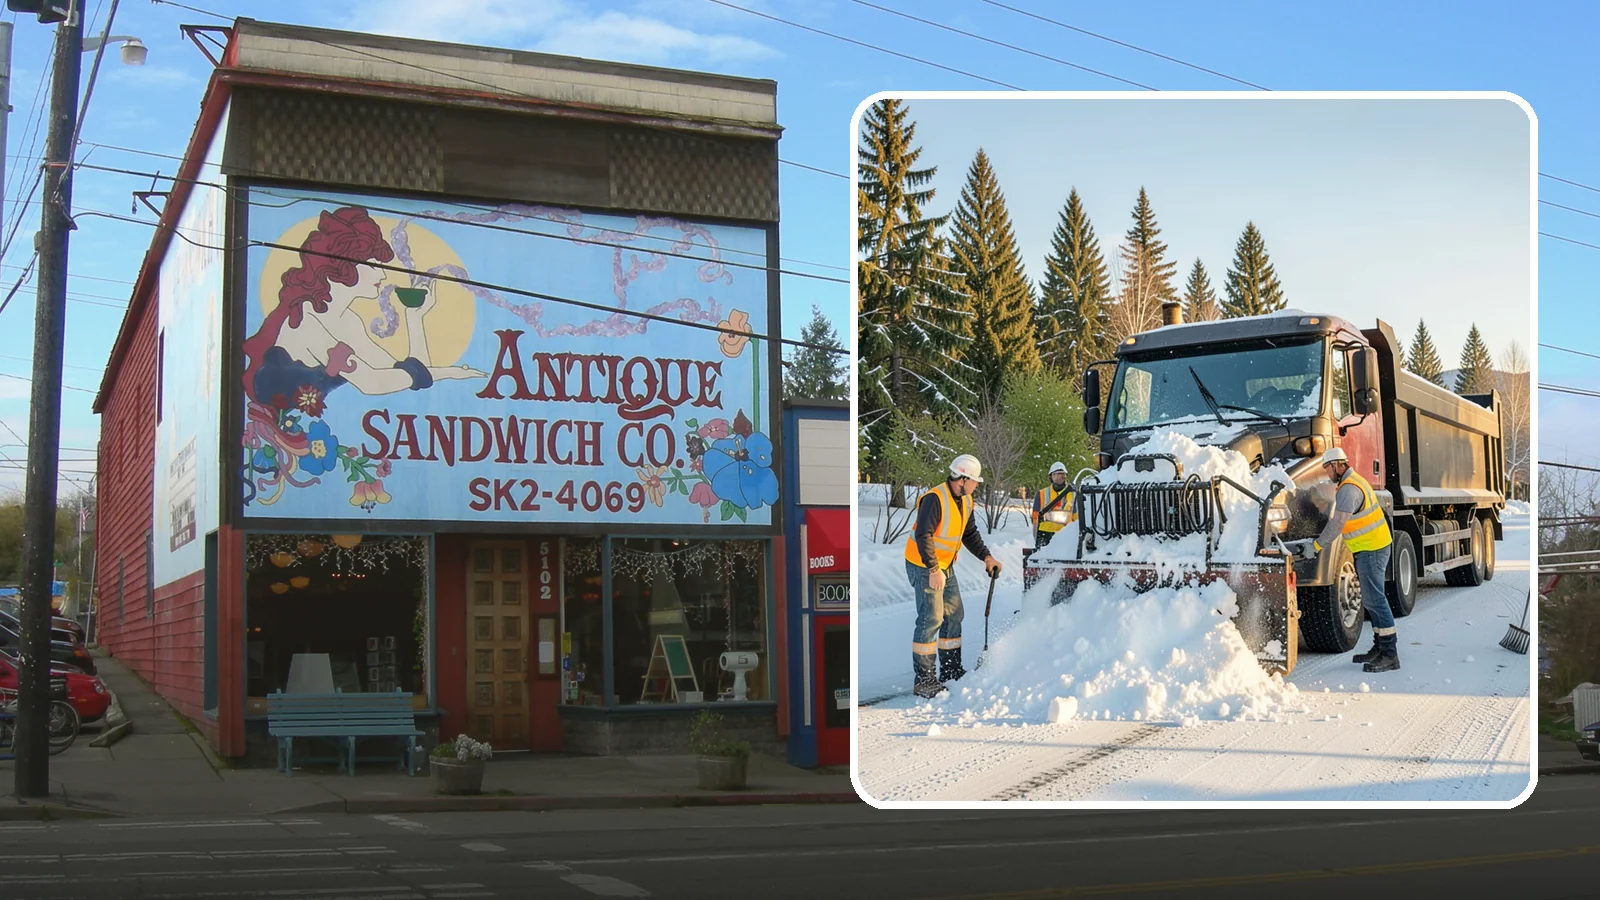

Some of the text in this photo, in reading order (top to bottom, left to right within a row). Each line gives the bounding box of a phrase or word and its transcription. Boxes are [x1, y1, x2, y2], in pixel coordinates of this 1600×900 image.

[476, 329, 724, 421] ANTIQUE
[361, 409, 685, 469] SANDWICH CO.
[468, 477, 646, 513] SK2-4069
[540, 541, 552, 600] 5102
[809, 555, 835, 569] BOOKS
